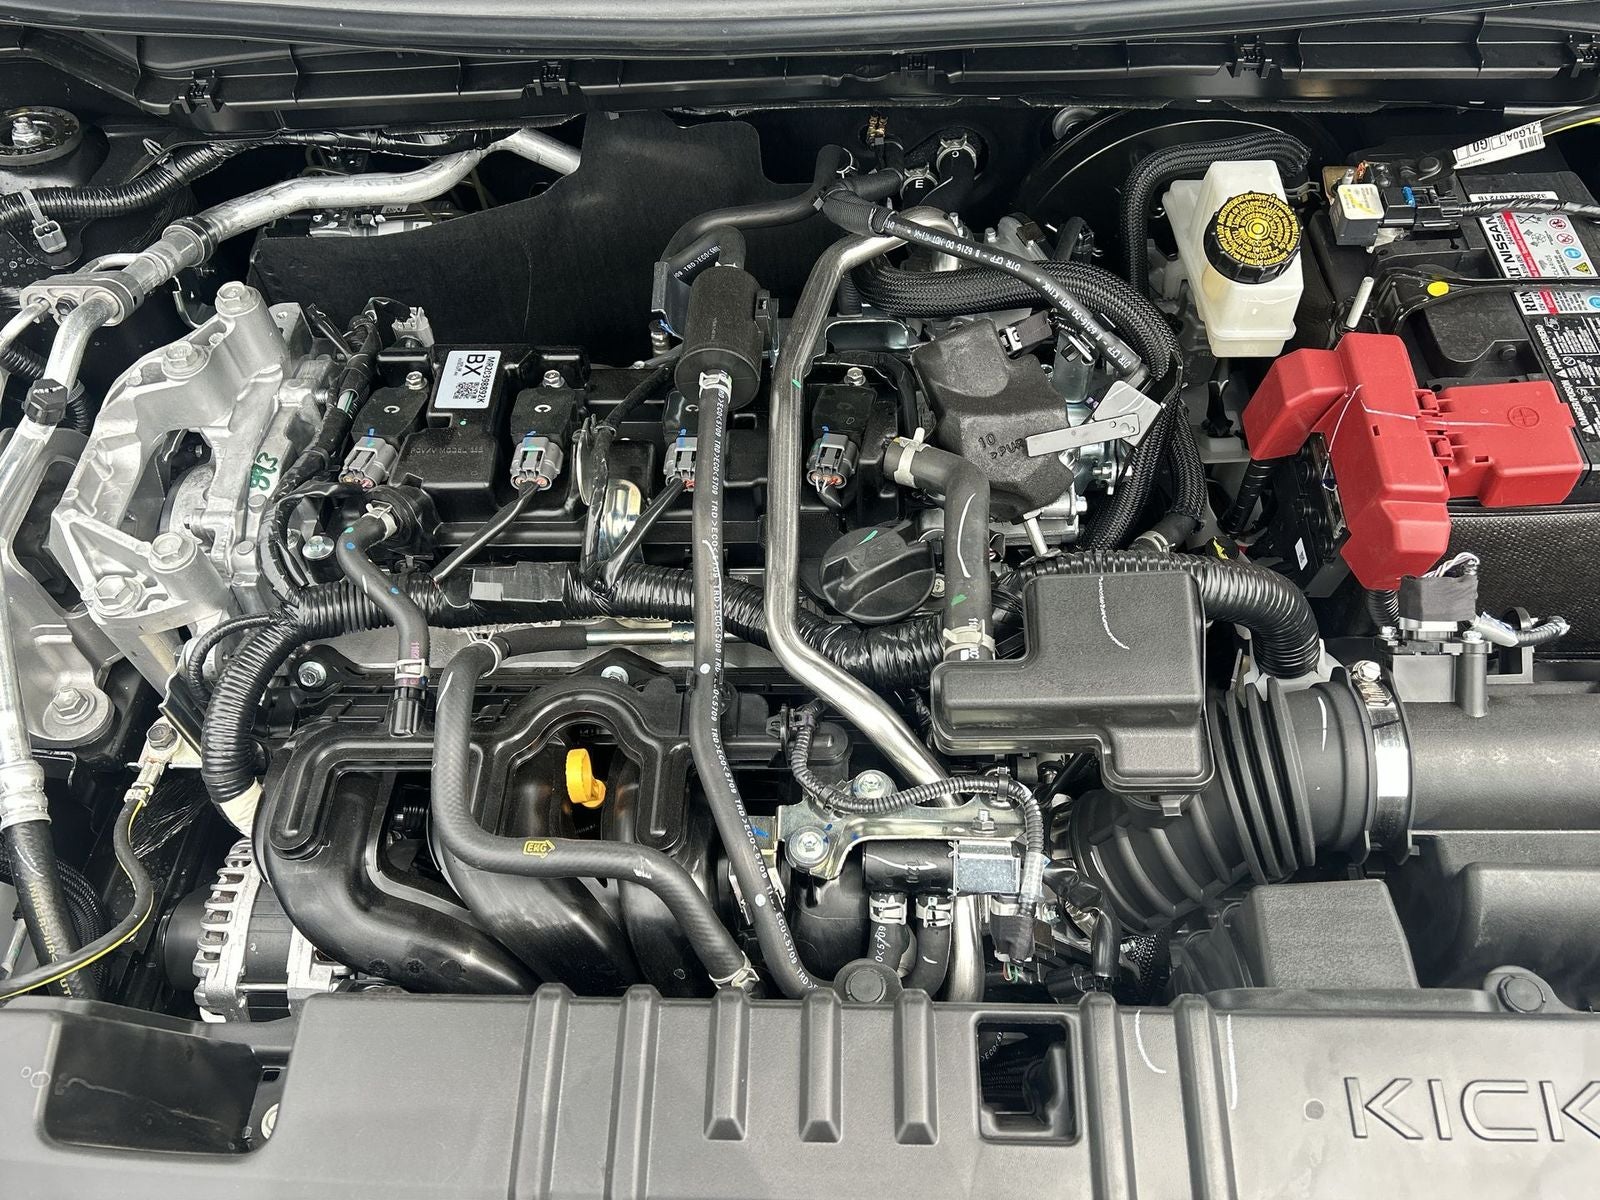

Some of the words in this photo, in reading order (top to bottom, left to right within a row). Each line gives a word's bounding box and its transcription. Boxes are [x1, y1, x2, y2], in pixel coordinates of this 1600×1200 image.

[915, 179, 924, 189] E
[462, 354, 486, 377] BX
[1343, 1077, 1600, 1142] KICK
